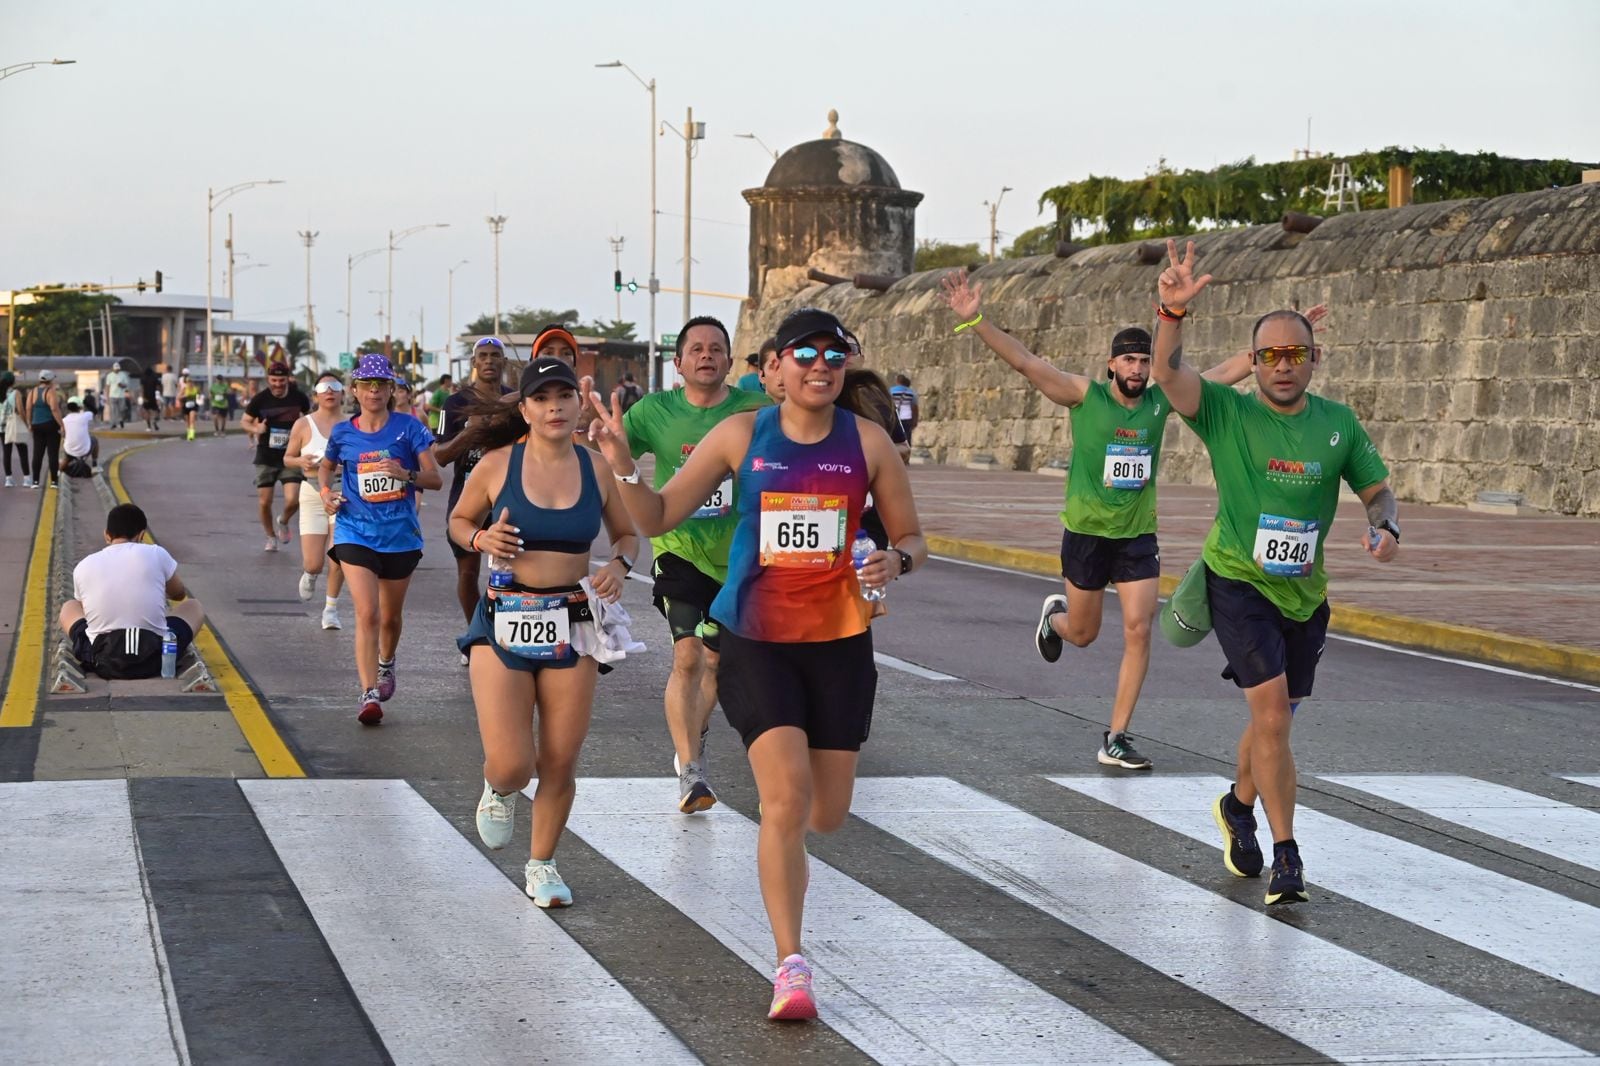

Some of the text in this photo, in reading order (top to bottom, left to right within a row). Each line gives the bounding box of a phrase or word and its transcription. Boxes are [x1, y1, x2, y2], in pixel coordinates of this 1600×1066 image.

[1113, 462, 1144, 478] 8016
[1267, 458, 1322, 475] MMM
[364, 476, 395, 493] 5027
[777, 522, 819, 549] 655
[1266, 539, 1309, 563] 8348
[508, 621, 557, 643] 7028
